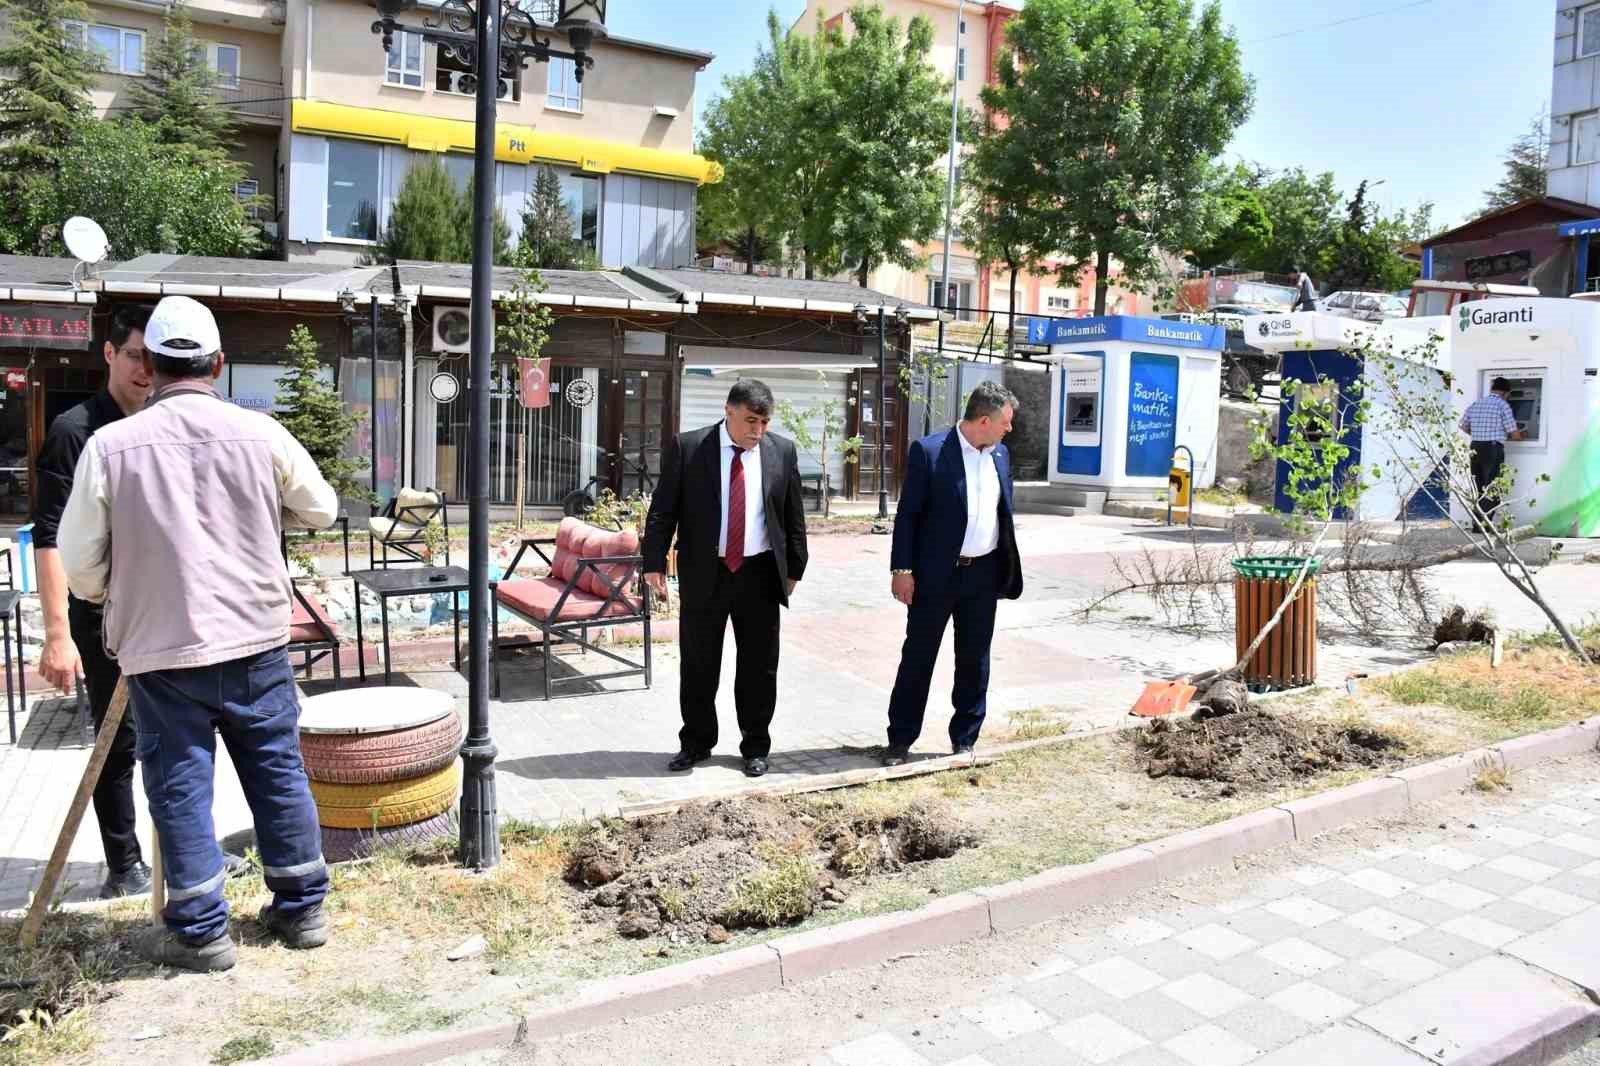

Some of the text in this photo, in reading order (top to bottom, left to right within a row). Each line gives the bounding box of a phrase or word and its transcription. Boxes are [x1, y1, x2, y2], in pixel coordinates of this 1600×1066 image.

[509, 139, 526, 152] Ptt
[1472, 307, 1533, 325] Garanti
[1057, 323, 1106, 337] Bankamatik
[1271, 319, 1291, 330] QNB
[1147, 325, 1202, 342] Bankamatik
